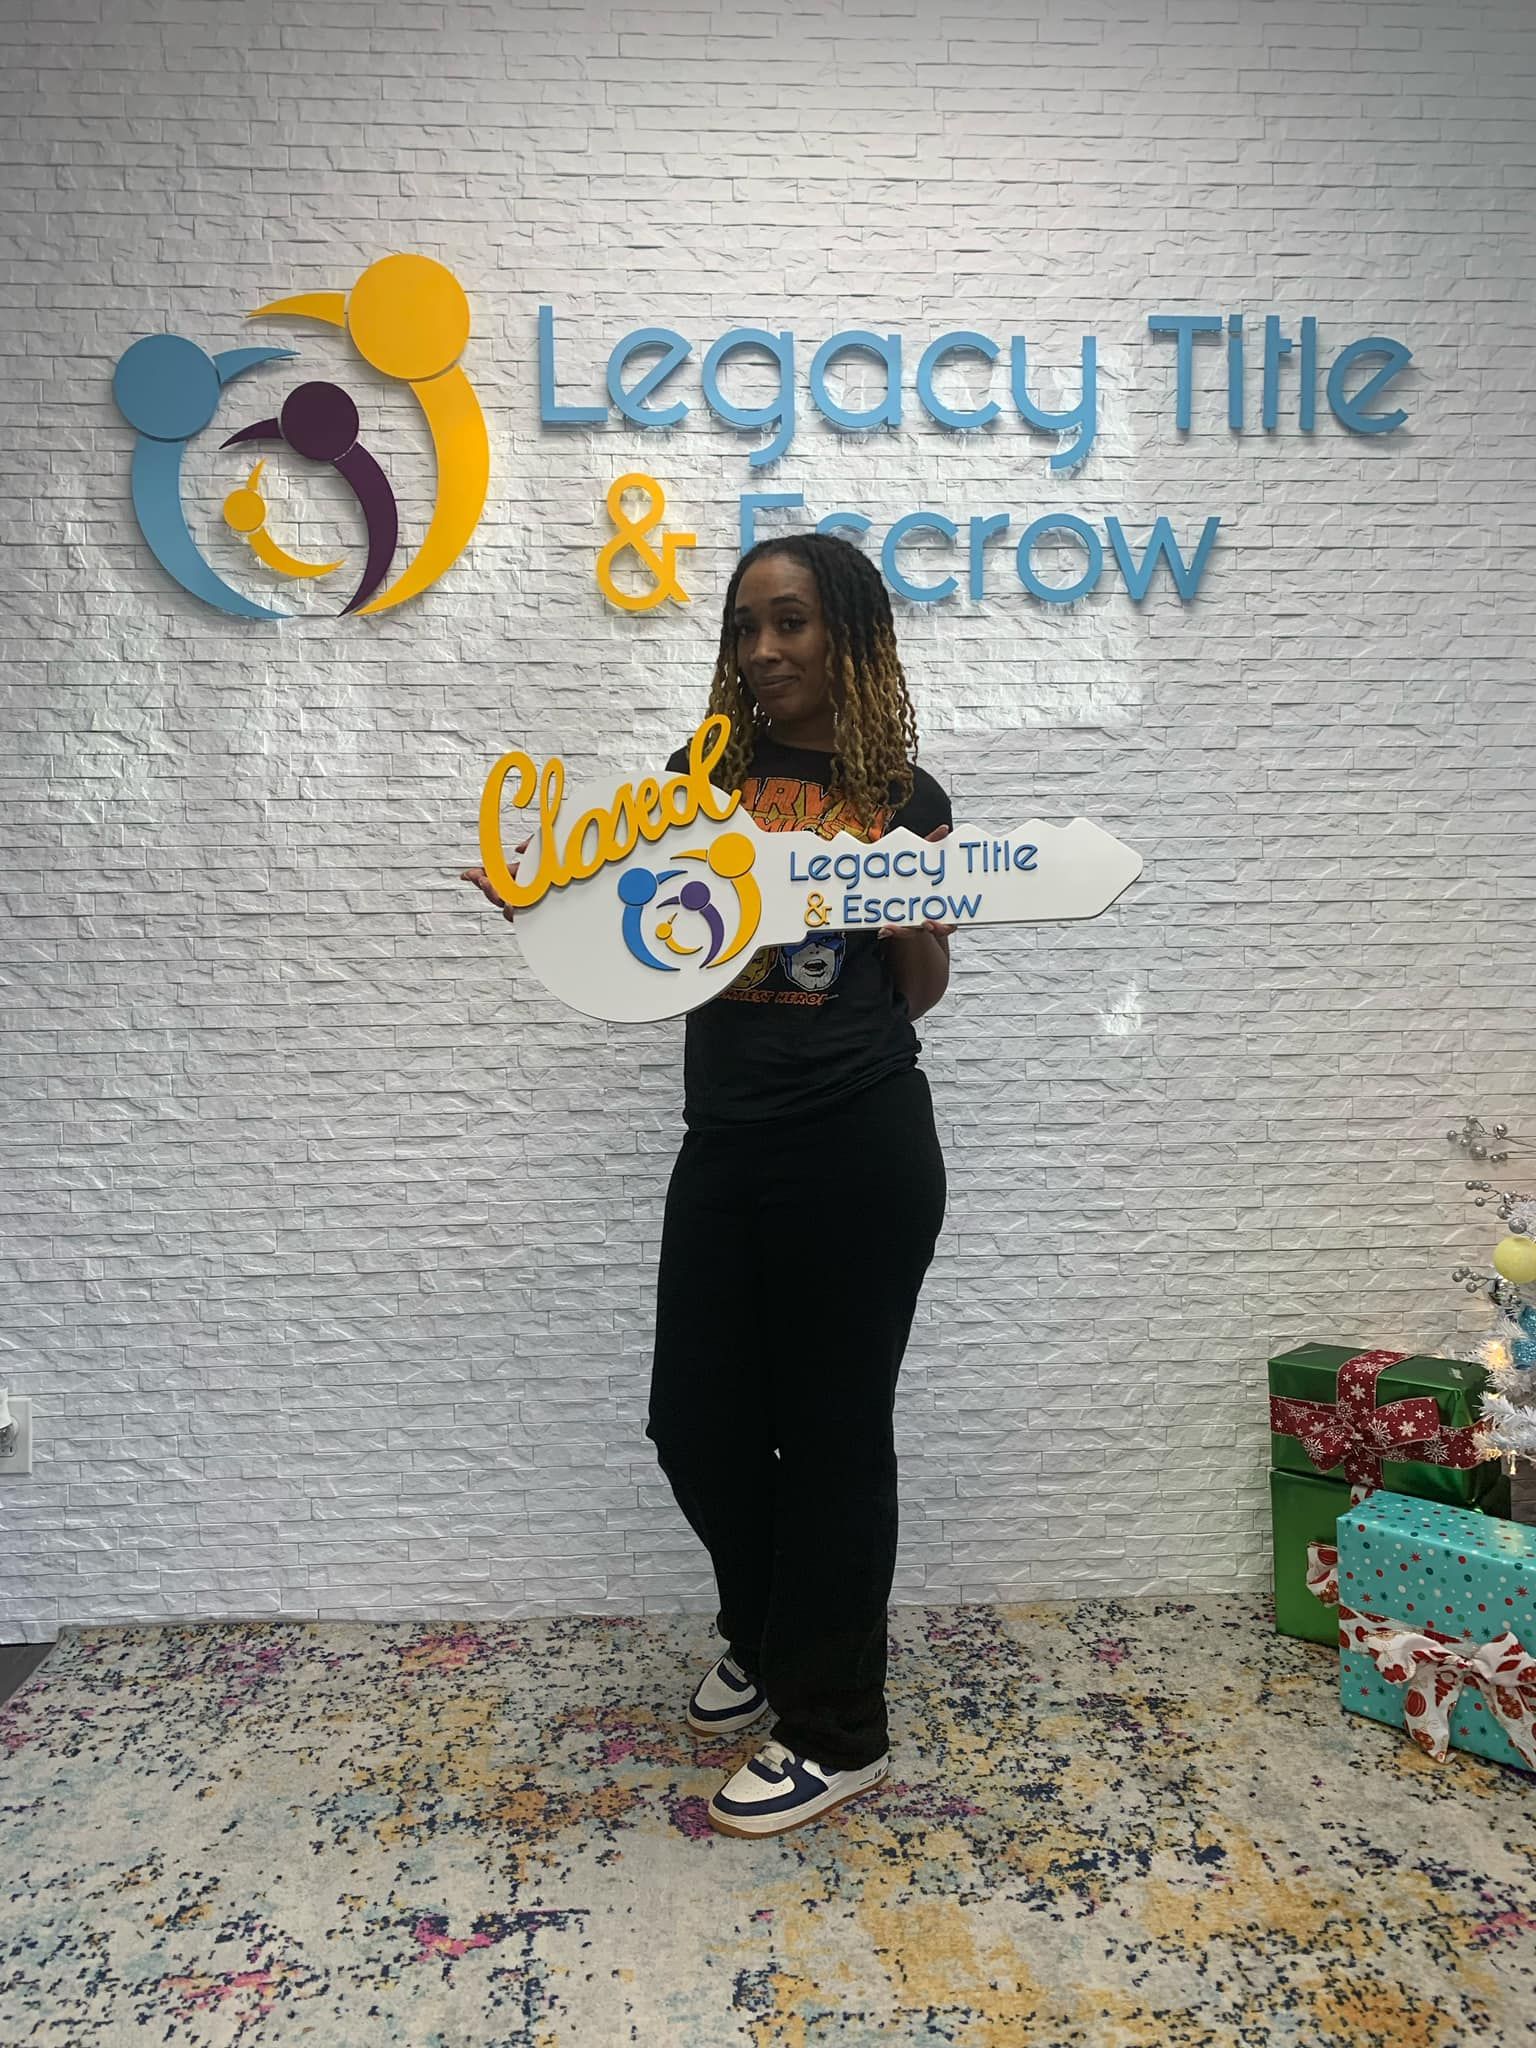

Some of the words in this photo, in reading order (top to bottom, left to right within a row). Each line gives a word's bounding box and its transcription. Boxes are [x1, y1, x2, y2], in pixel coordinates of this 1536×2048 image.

[538, 305, 1097, 470] Legacy
[1148, 314, 1414, 435] Title
[597, 471, 698, 611] &
[740, 493, 1220, 602] crow
[479, 713, 742, 908] Closed
[790, 849, 945, 889] Legacy
[959, 840, 1039, 873] Title
[804, 891, 832, 928] &
[843, 893, 983, 923] Escrow
